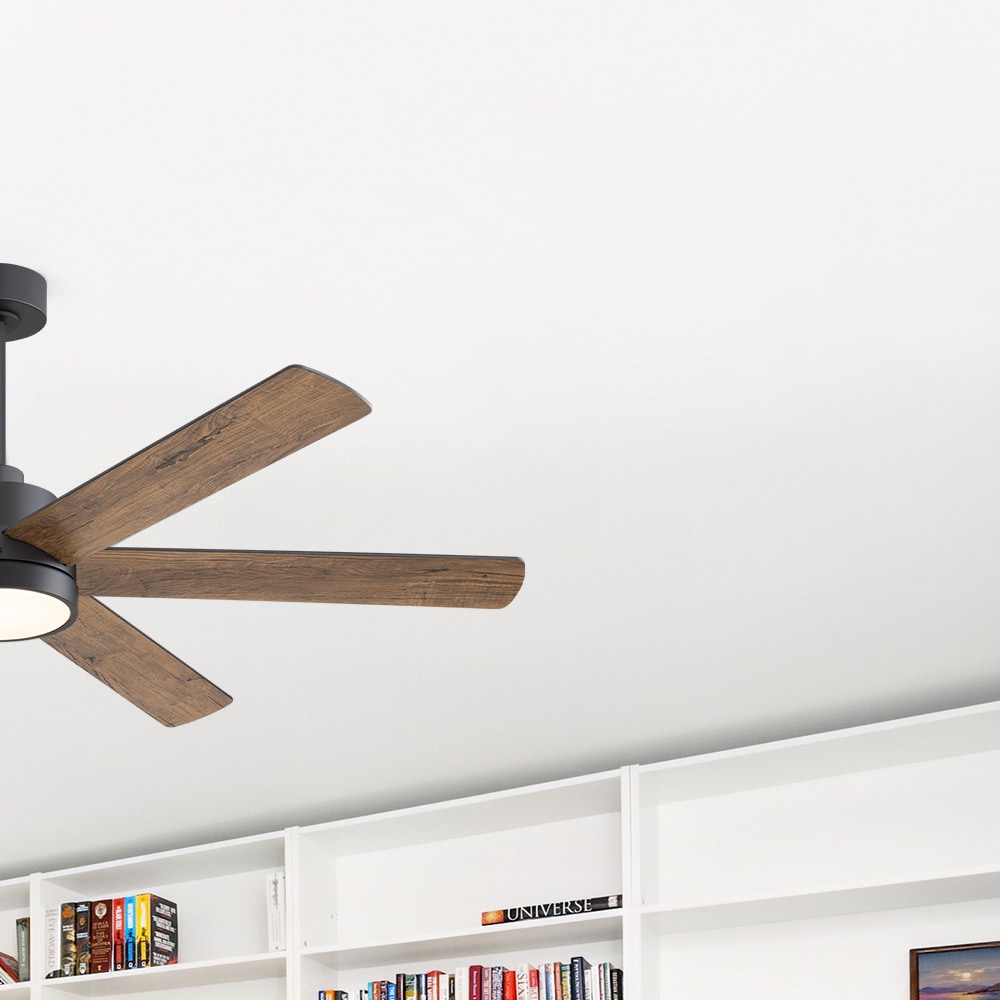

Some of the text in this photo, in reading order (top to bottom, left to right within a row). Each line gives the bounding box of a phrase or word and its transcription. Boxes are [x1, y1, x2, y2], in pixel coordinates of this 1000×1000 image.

[507, 899, 592, 920] UNIVERSE
[48, 918, 56, 968] EYE WORLD
